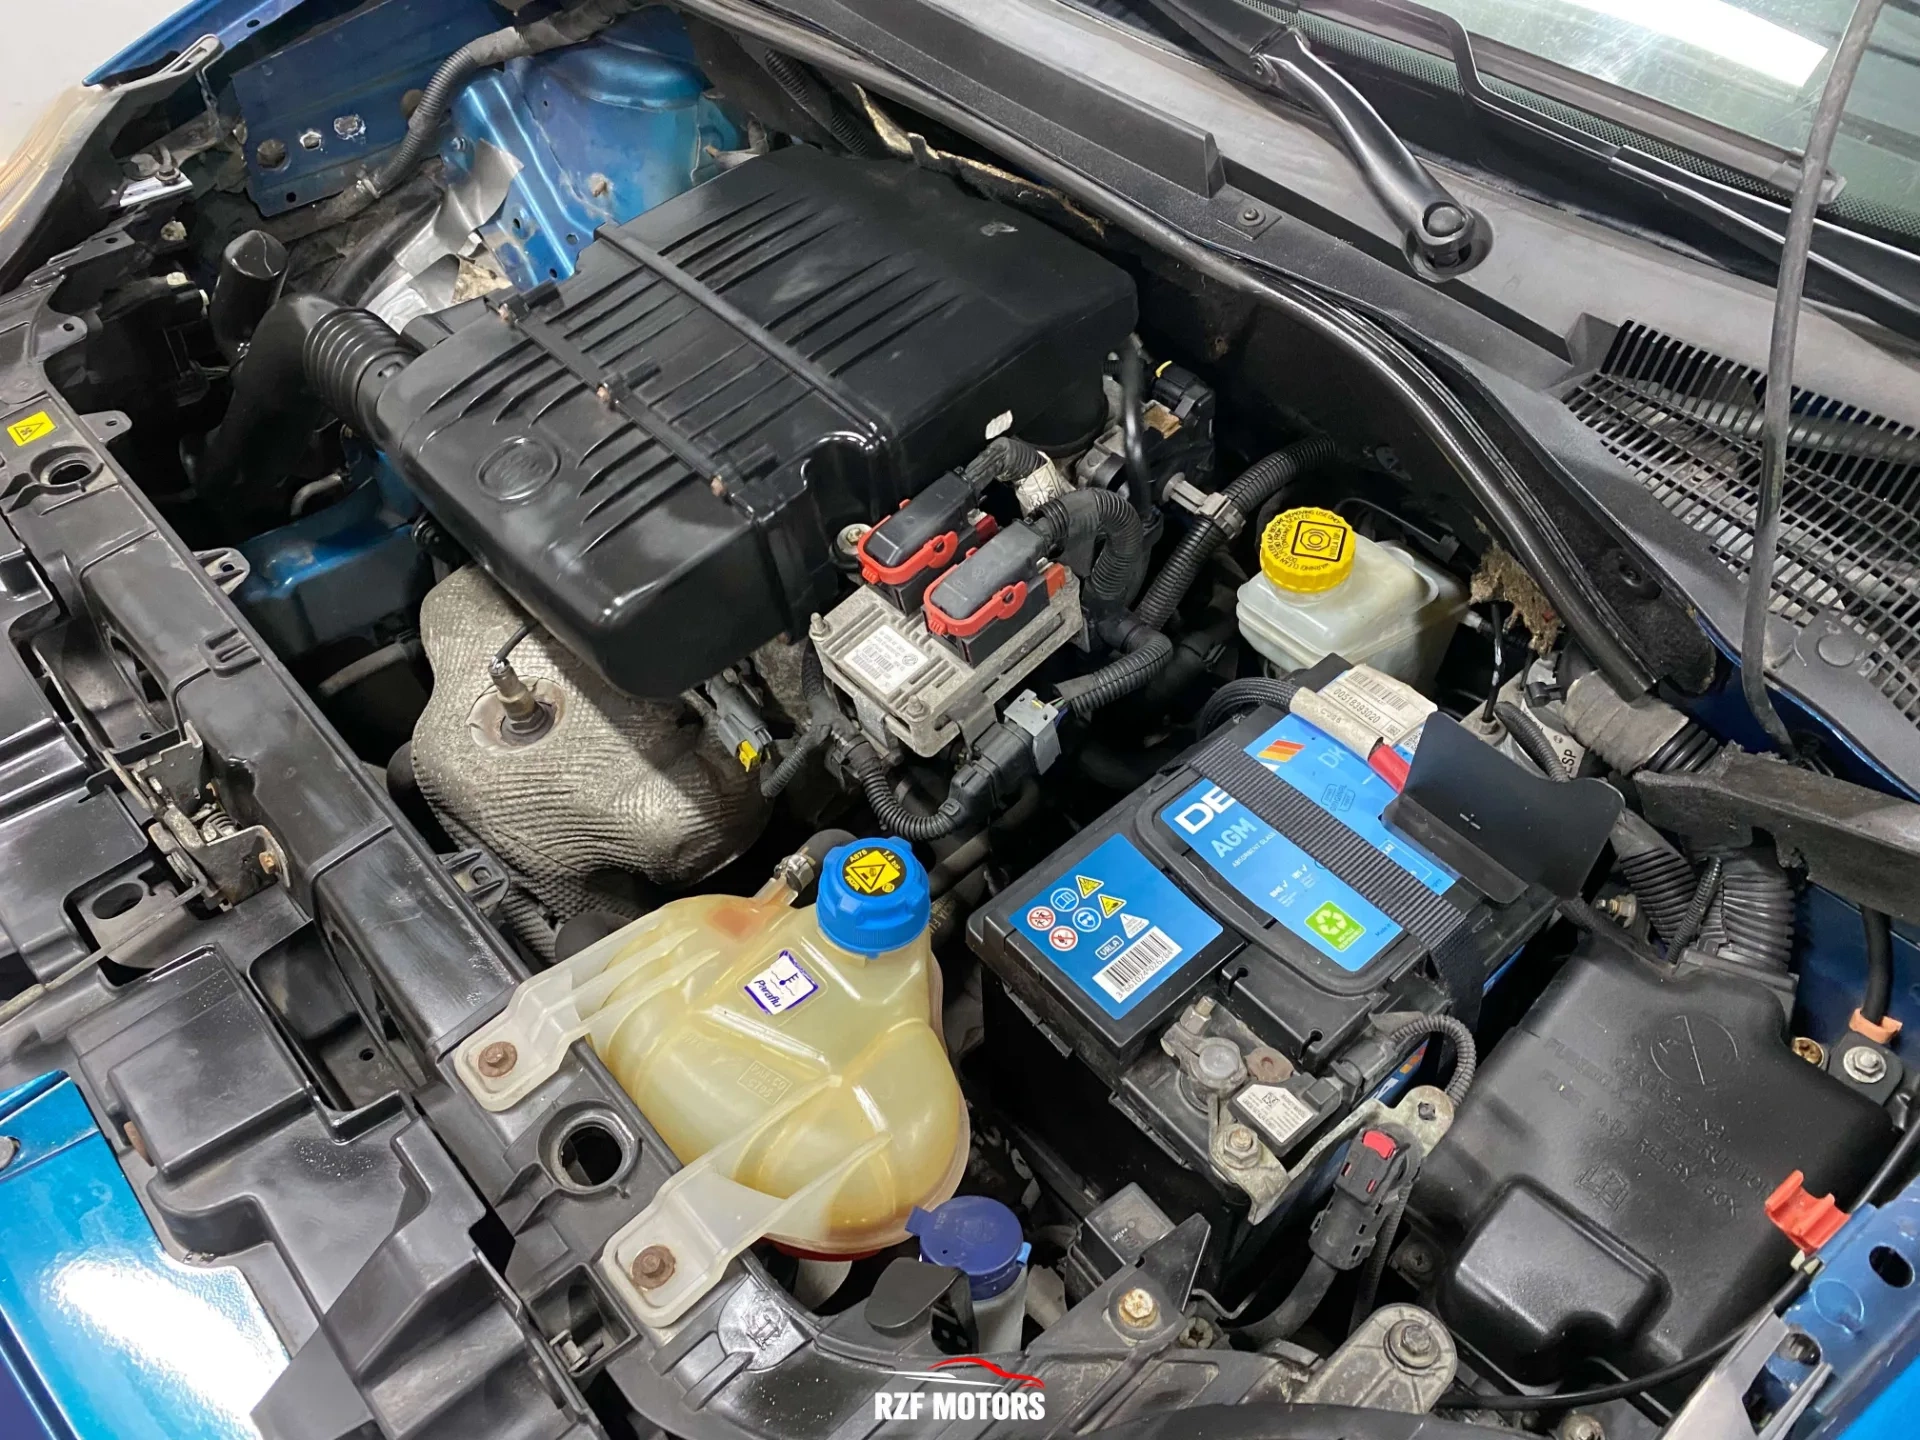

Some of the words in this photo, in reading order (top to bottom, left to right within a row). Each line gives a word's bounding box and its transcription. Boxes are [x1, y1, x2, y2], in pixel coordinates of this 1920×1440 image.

[1211, 817, 1258, 859] AGM
[1100, 940, 1120, 956] VRLA
[754, 979, 782, 1008] Paraflu
[1633, 1136, 1698, 1188] RELAY
[1703, 1183, 1741, 1217] BOX
